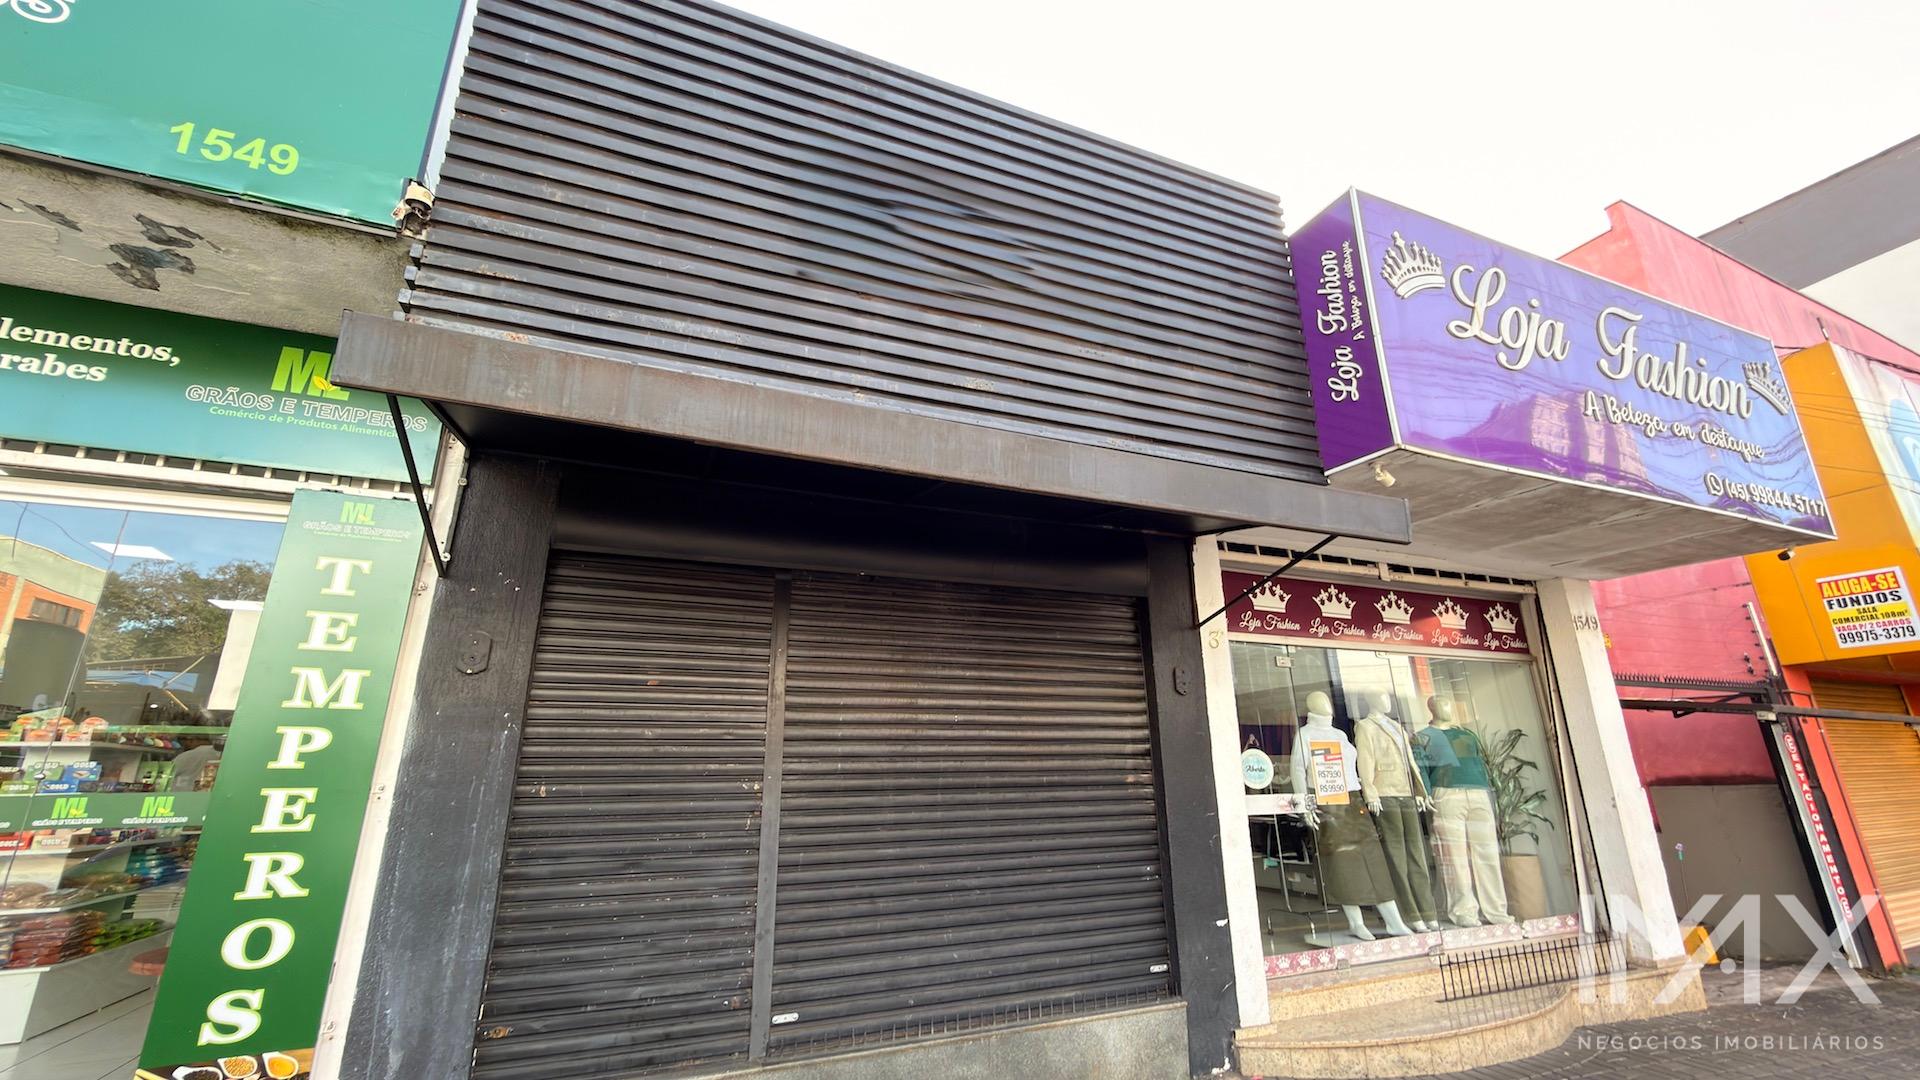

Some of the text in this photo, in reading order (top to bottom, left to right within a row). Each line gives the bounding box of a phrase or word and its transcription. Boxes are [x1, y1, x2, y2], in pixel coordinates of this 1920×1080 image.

[170, 121, 300, 176] 1549
[1316, 250, 1363, 402] Loja Fashion
[0, 317, 181, 367] lementos,
[1447, 264, 1752, 420] Loja Fashion
[0, 353, 108, 382] rabes
[185, 384, 428, 432] GRÃOS E TEMPEROS
[209, 406, 399, 439] Comércio de Produtos Alimentíci
[1584, 391, 1765, 463] A Beleza em destaque
[1725, 480, 1827, 517] (45) 99844-5717
[340, 501, 376, 526] ML
[1821, 572, 1899, 598] ALUGA-SE
[1826, 590, 1903, 610] FUNDOS
[1856, 606, 1878, 615] SALA
[1239, 611, 1301, 632] Loja Fashion
[1309, 617, 1366, 638] Loja Fashion
[1832, 613, 1880, 625] COMERCIAL
[1836, 624, 1859, 632] VAGA
[1875, 618, 1912, 629] CARROS
[1371, 623, 1424, 642] Loja Fashion
[1430, 628, 1479, 647] Loja Fashion
[1483, 632, 1528, 651] Loja Fashion
[1839, 625, 1916, 644] 99975-3379
[51, 797, 89, 819] ML
[140, 796, 176, 818] ML
[197, 555, 373, 1047] TEMPEROS
